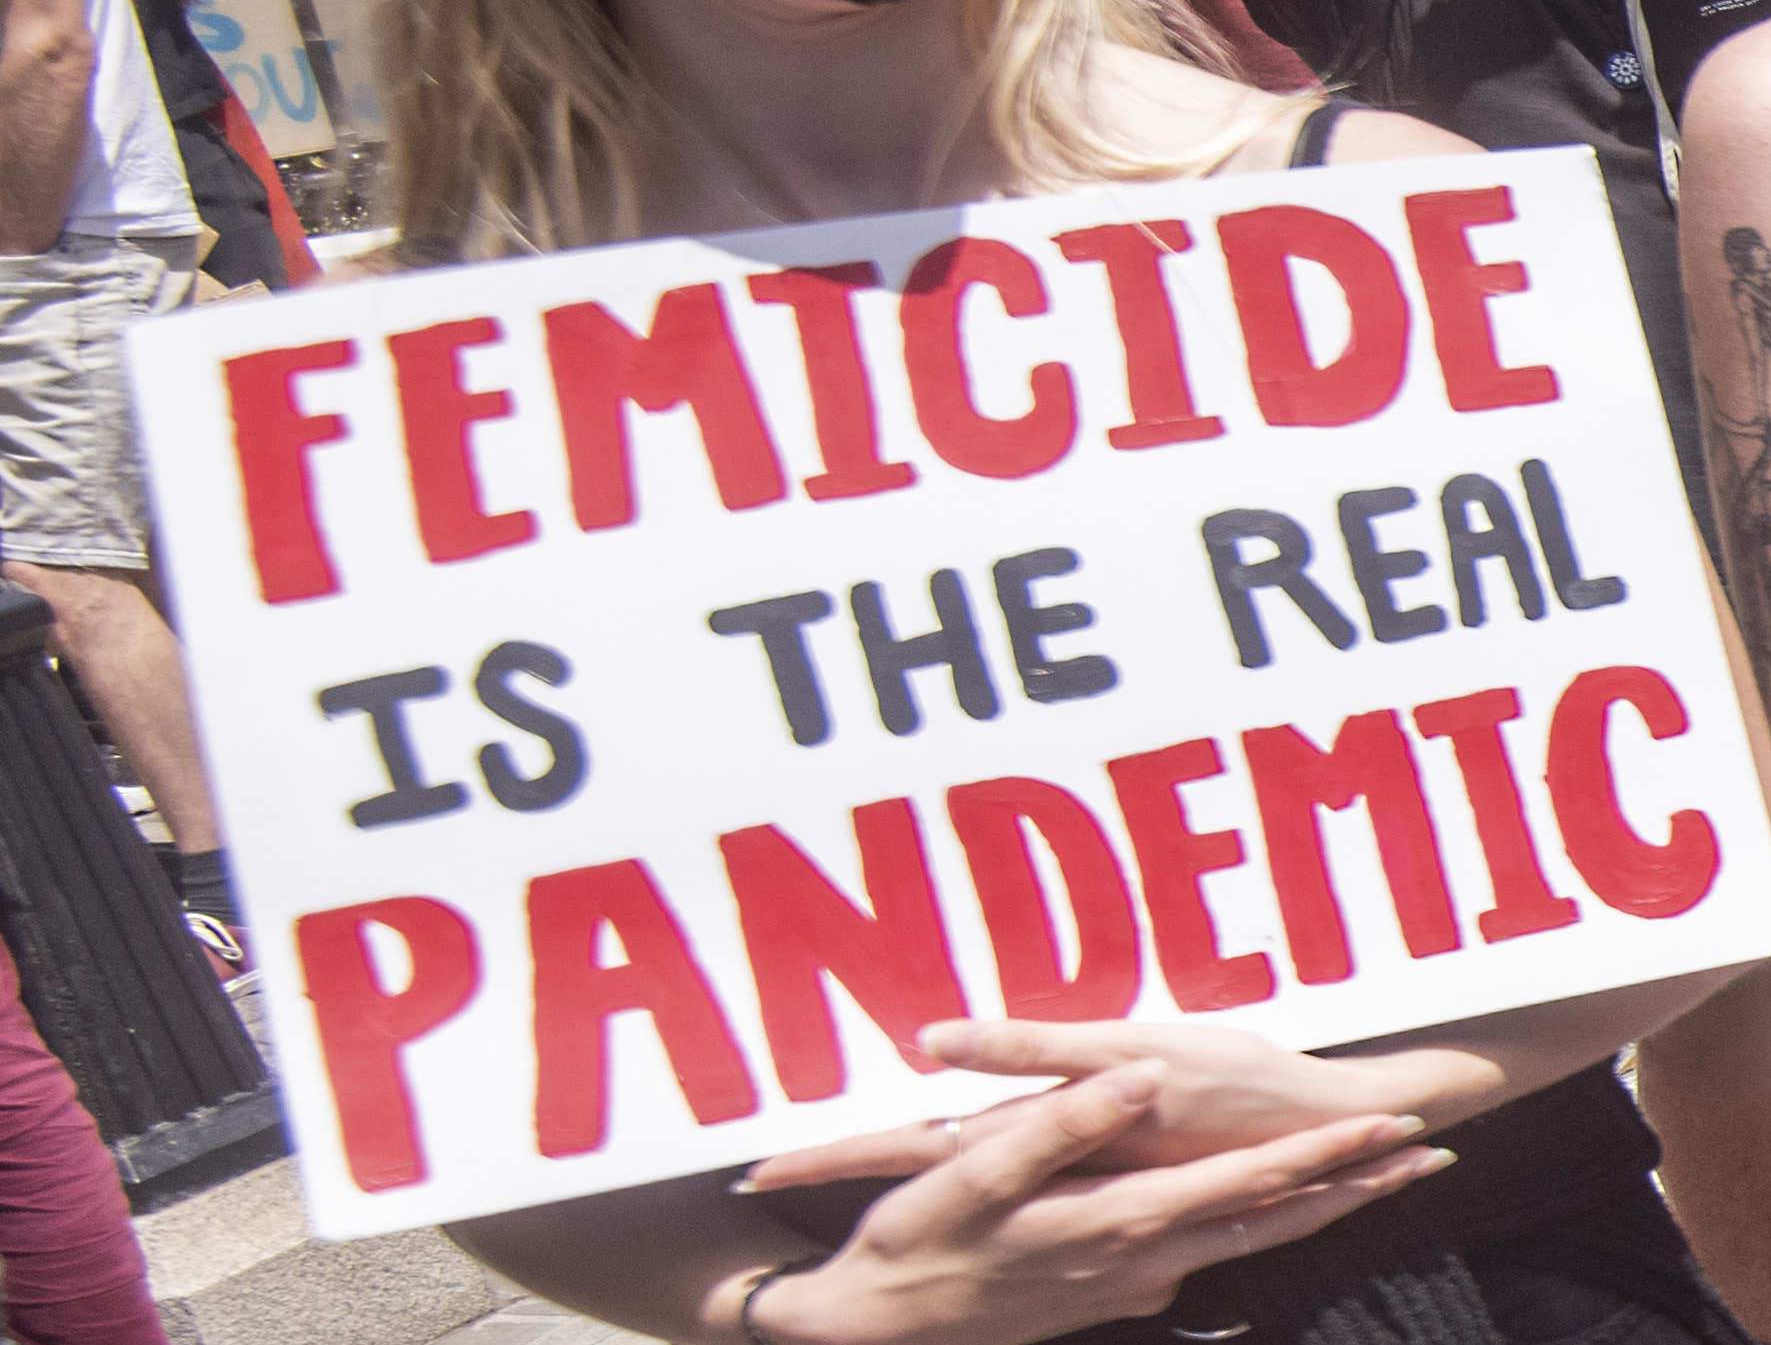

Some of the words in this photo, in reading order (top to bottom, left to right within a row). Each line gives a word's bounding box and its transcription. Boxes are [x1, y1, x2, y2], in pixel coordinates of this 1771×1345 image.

[220, 184, 1563, 606] FEMICIDE
[314, 637, 591, 831] IS
[708, 545, 1121, 748] THE
[1200, 456, 1628, 670] REAL
[294, 663, 1725, 1194] PANDEMIC
